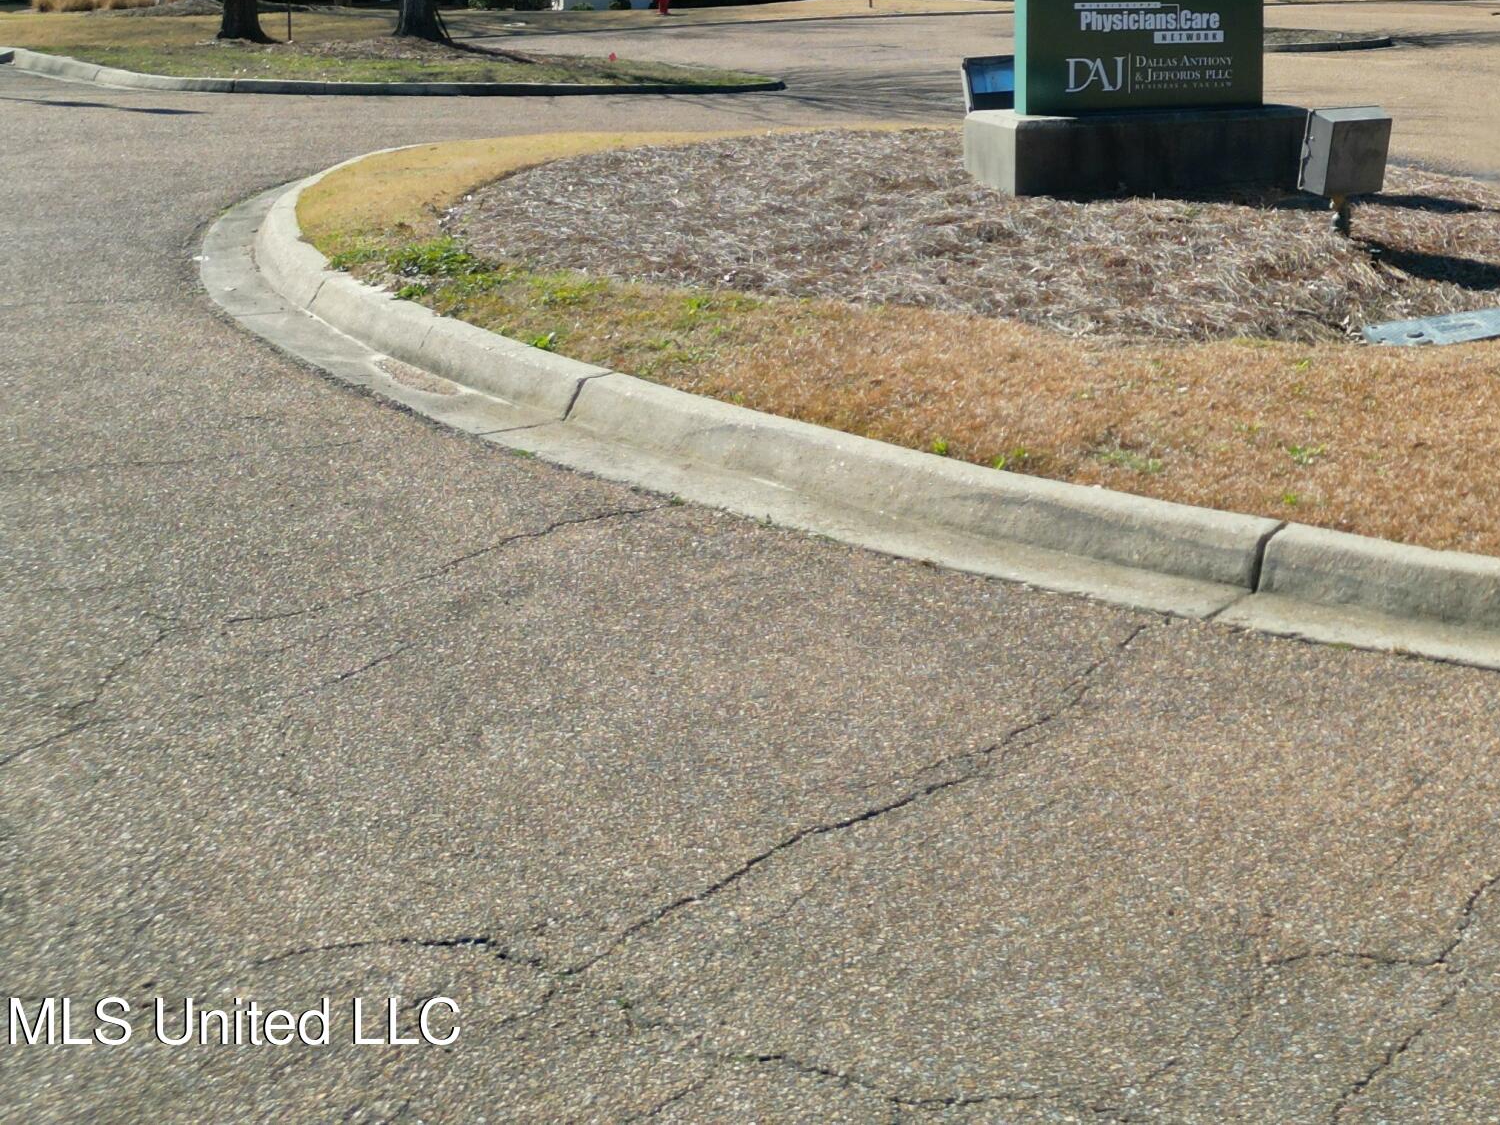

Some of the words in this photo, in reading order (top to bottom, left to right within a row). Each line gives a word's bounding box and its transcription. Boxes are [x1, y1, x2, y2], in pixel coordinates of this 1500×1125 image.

[1161, 32, 1218, 41] NETWORK
[1135, 72, 1143, 81] &
[1205, 69, 1233, 79] PLLC
